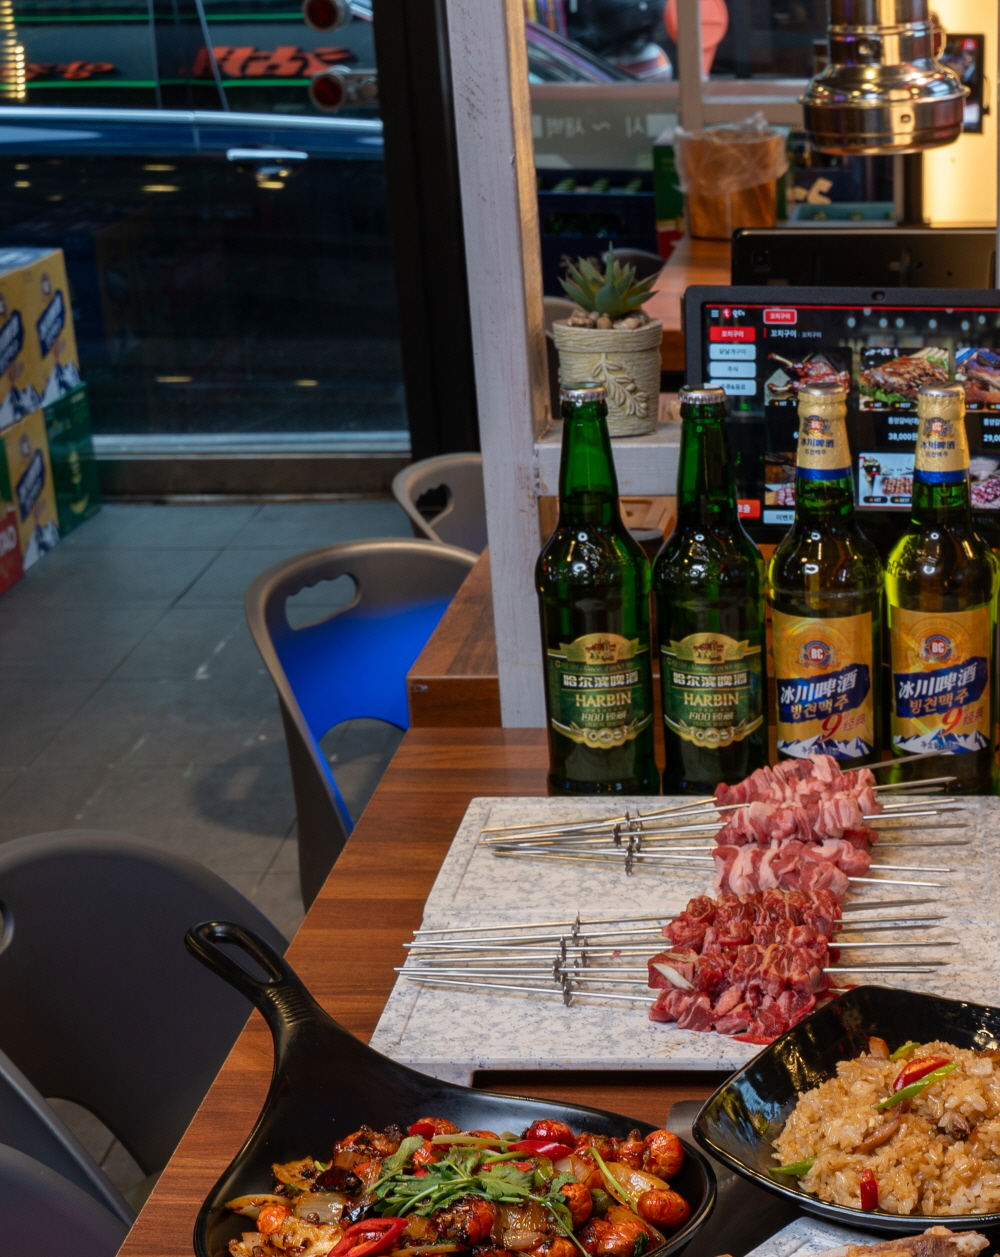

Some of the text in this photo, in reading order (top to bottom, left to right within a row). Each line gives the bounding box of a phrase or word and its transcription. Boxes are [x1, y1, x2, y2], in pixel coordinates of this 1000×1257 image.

[770, 329, 797, 338] 꼬치구이
[811, 648, 823, 660] BC
[932, 642, 944, 653] BC
[781, 669, 858, 704] 冰川啤酒
[899, 662, 977, 699] 冰川啤酒
[575, 691, 632, 708] HARBIN
[684, 692, 739, 707] HARBIN
[791, 694, 849, 719] 빙천맥주
[910, 688, 969, 714] 빙천맥주
[581, 712, 604, 721] 1900
[689, 712, 711, 721] 1900
